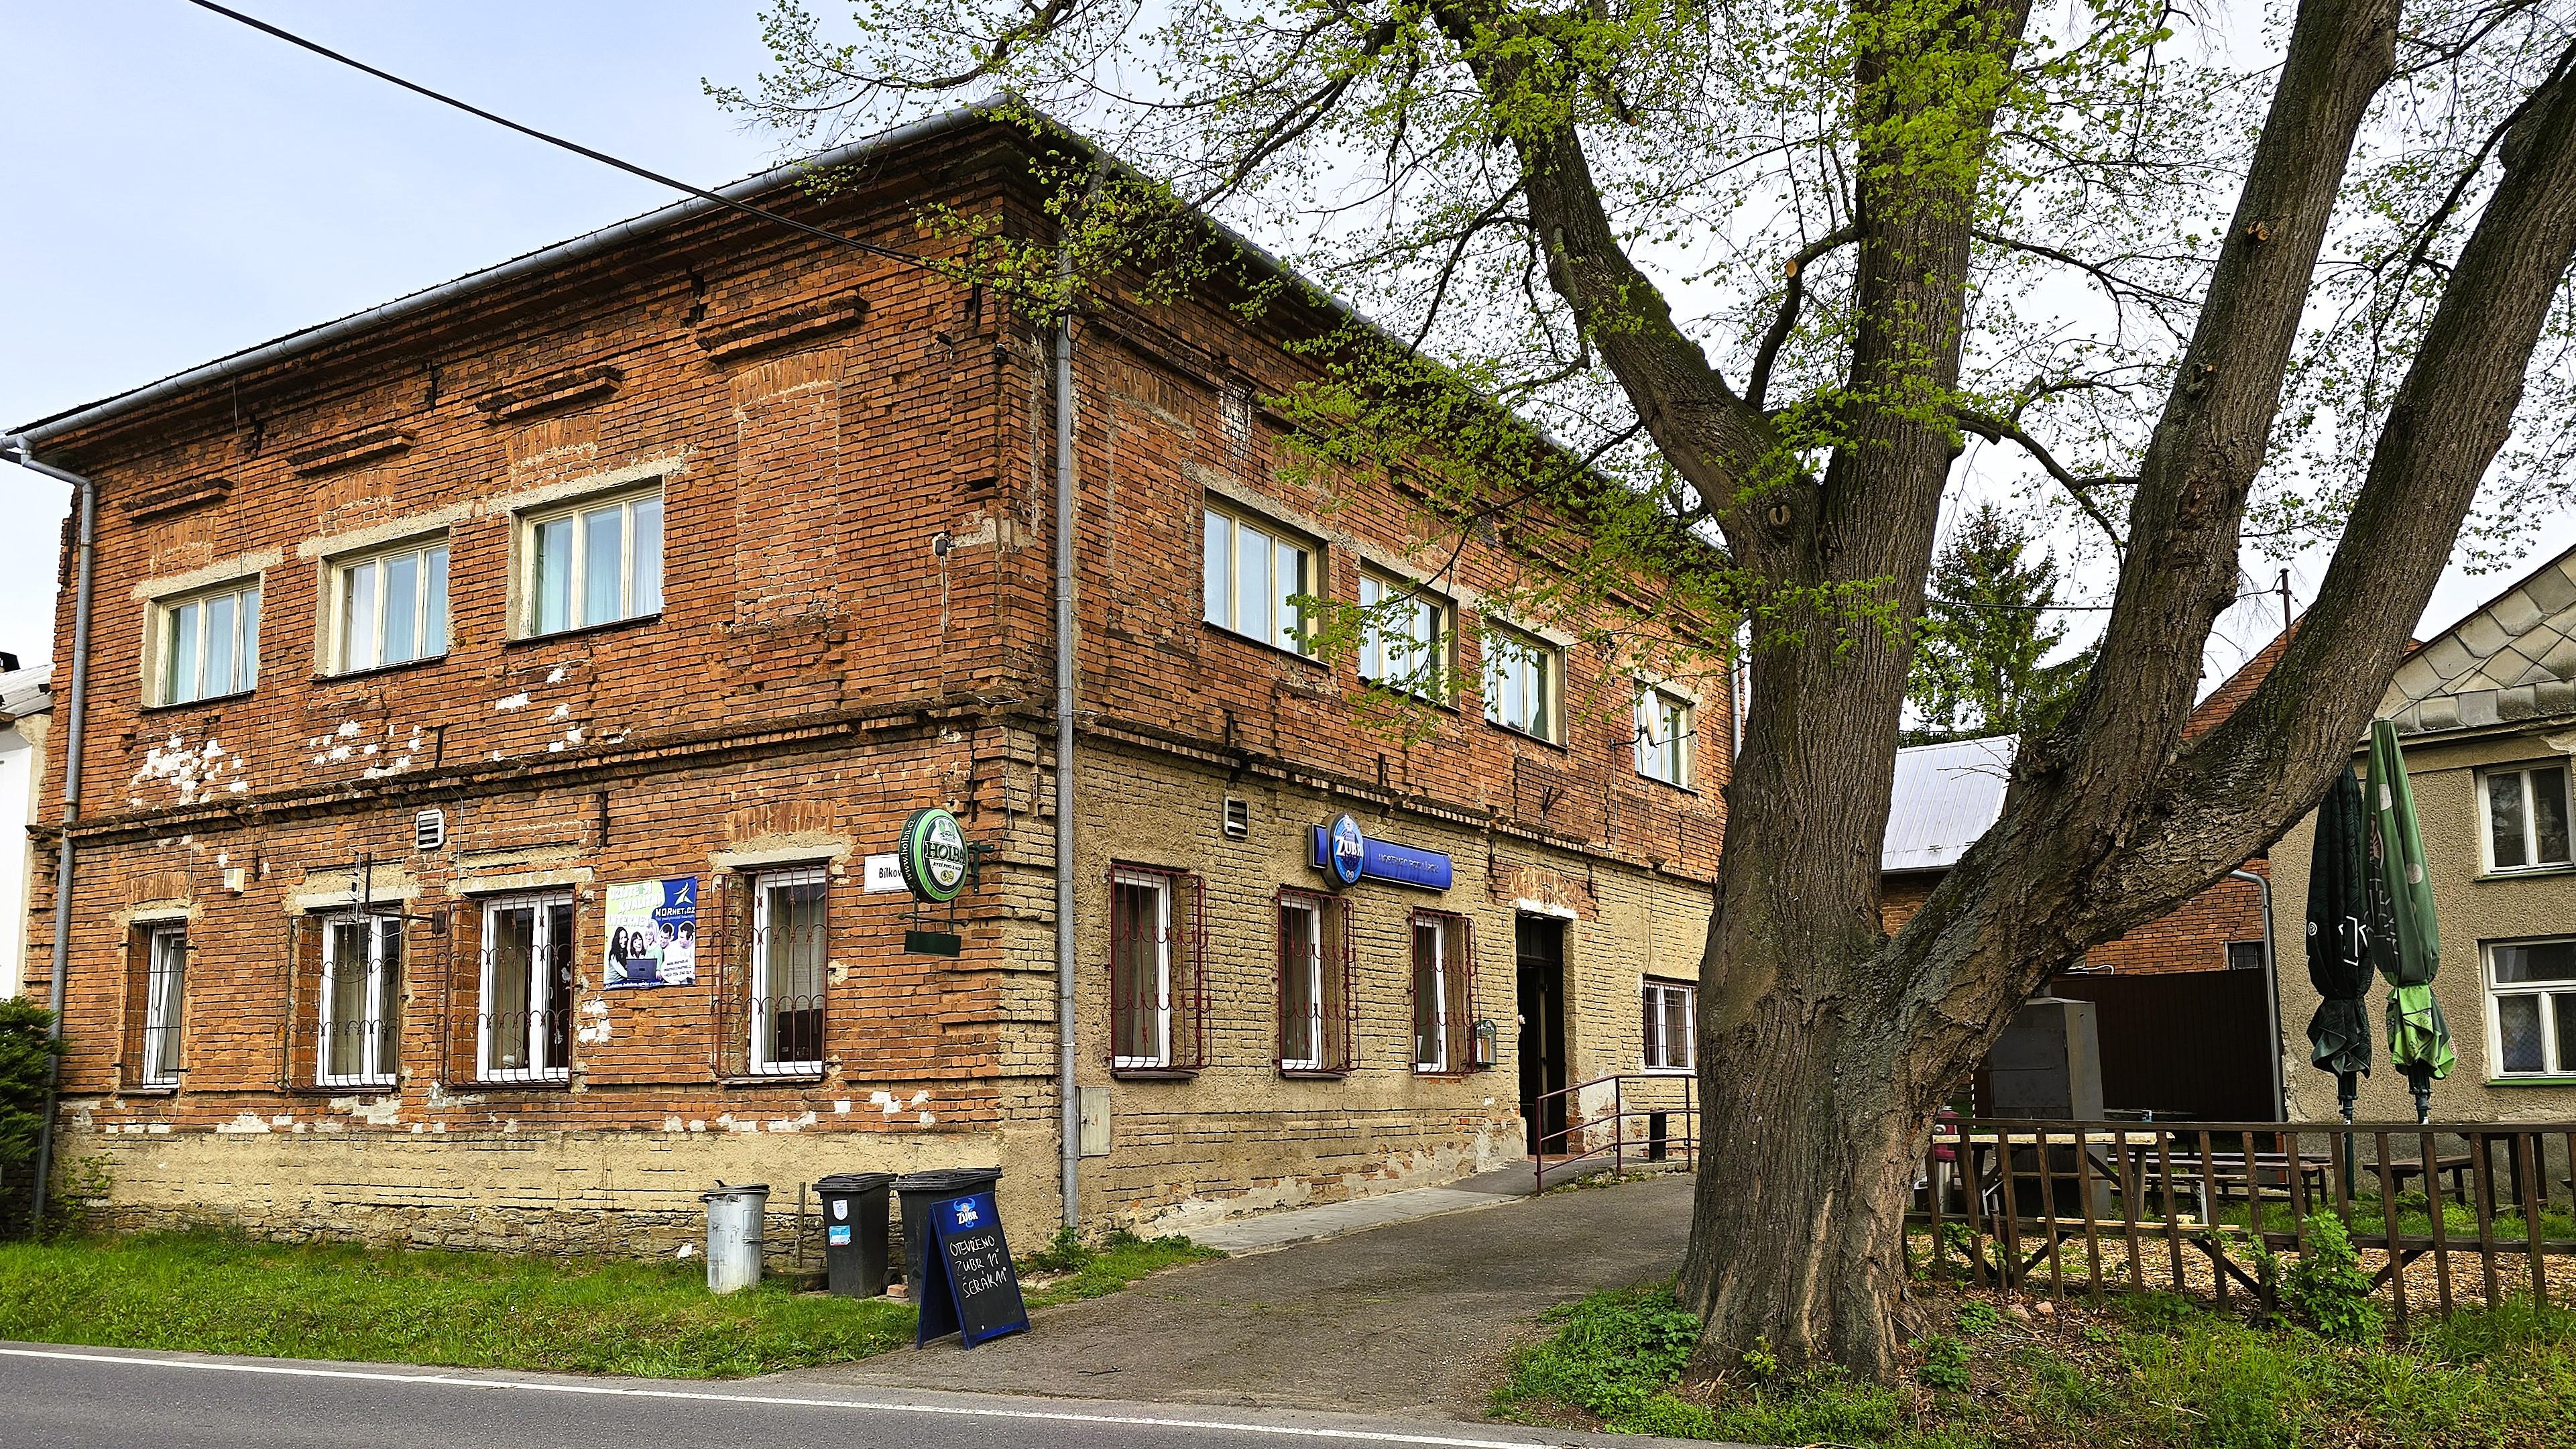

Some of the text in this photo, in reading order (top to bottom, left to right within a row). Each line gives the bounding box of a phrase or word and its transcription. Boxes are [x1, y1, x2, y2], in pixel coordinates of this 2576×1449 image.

[900, 819, 916, 880] www.holba.cz
[925, 842, 965, 864] HOLBA
[1335, 835, 1363, 857] ZUBR
[655, 907, 695, 917] MORNET.CZ
[956, 1210, 978, 1224] ZUBR
[954, 1258, 984, 1277] ZUBR
